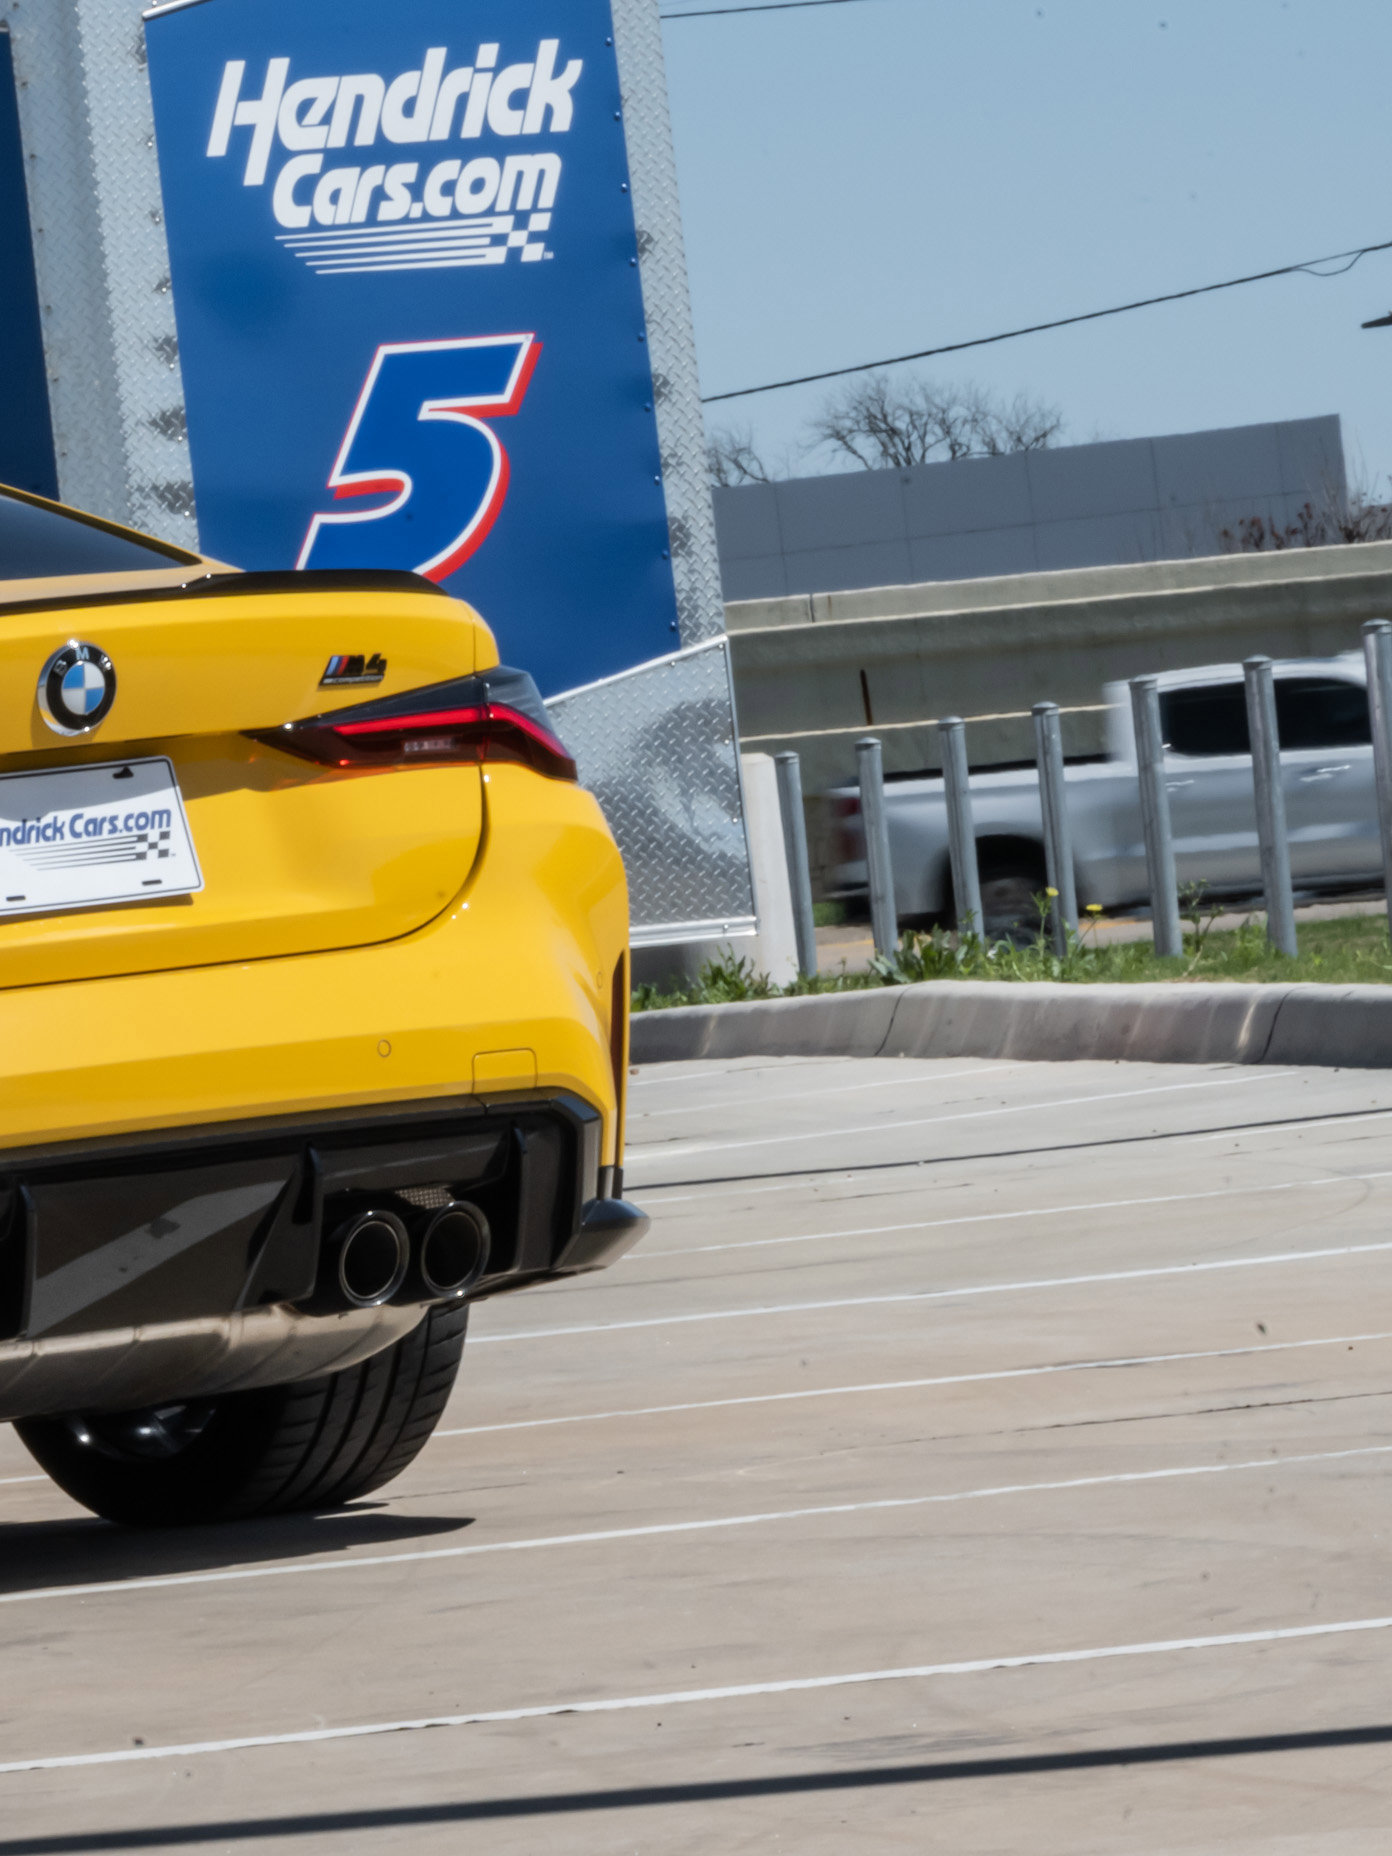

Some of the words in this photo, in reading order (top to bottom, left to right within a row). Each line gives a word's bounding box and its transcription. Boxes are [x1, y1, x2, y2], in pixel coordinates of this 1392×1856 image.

[205, 38, 584, 187] Hendrick
[272, 152, 563, 229] Cars.com
[294, 331, 544, 585] 5
[343, 652, 387, 676] M4
